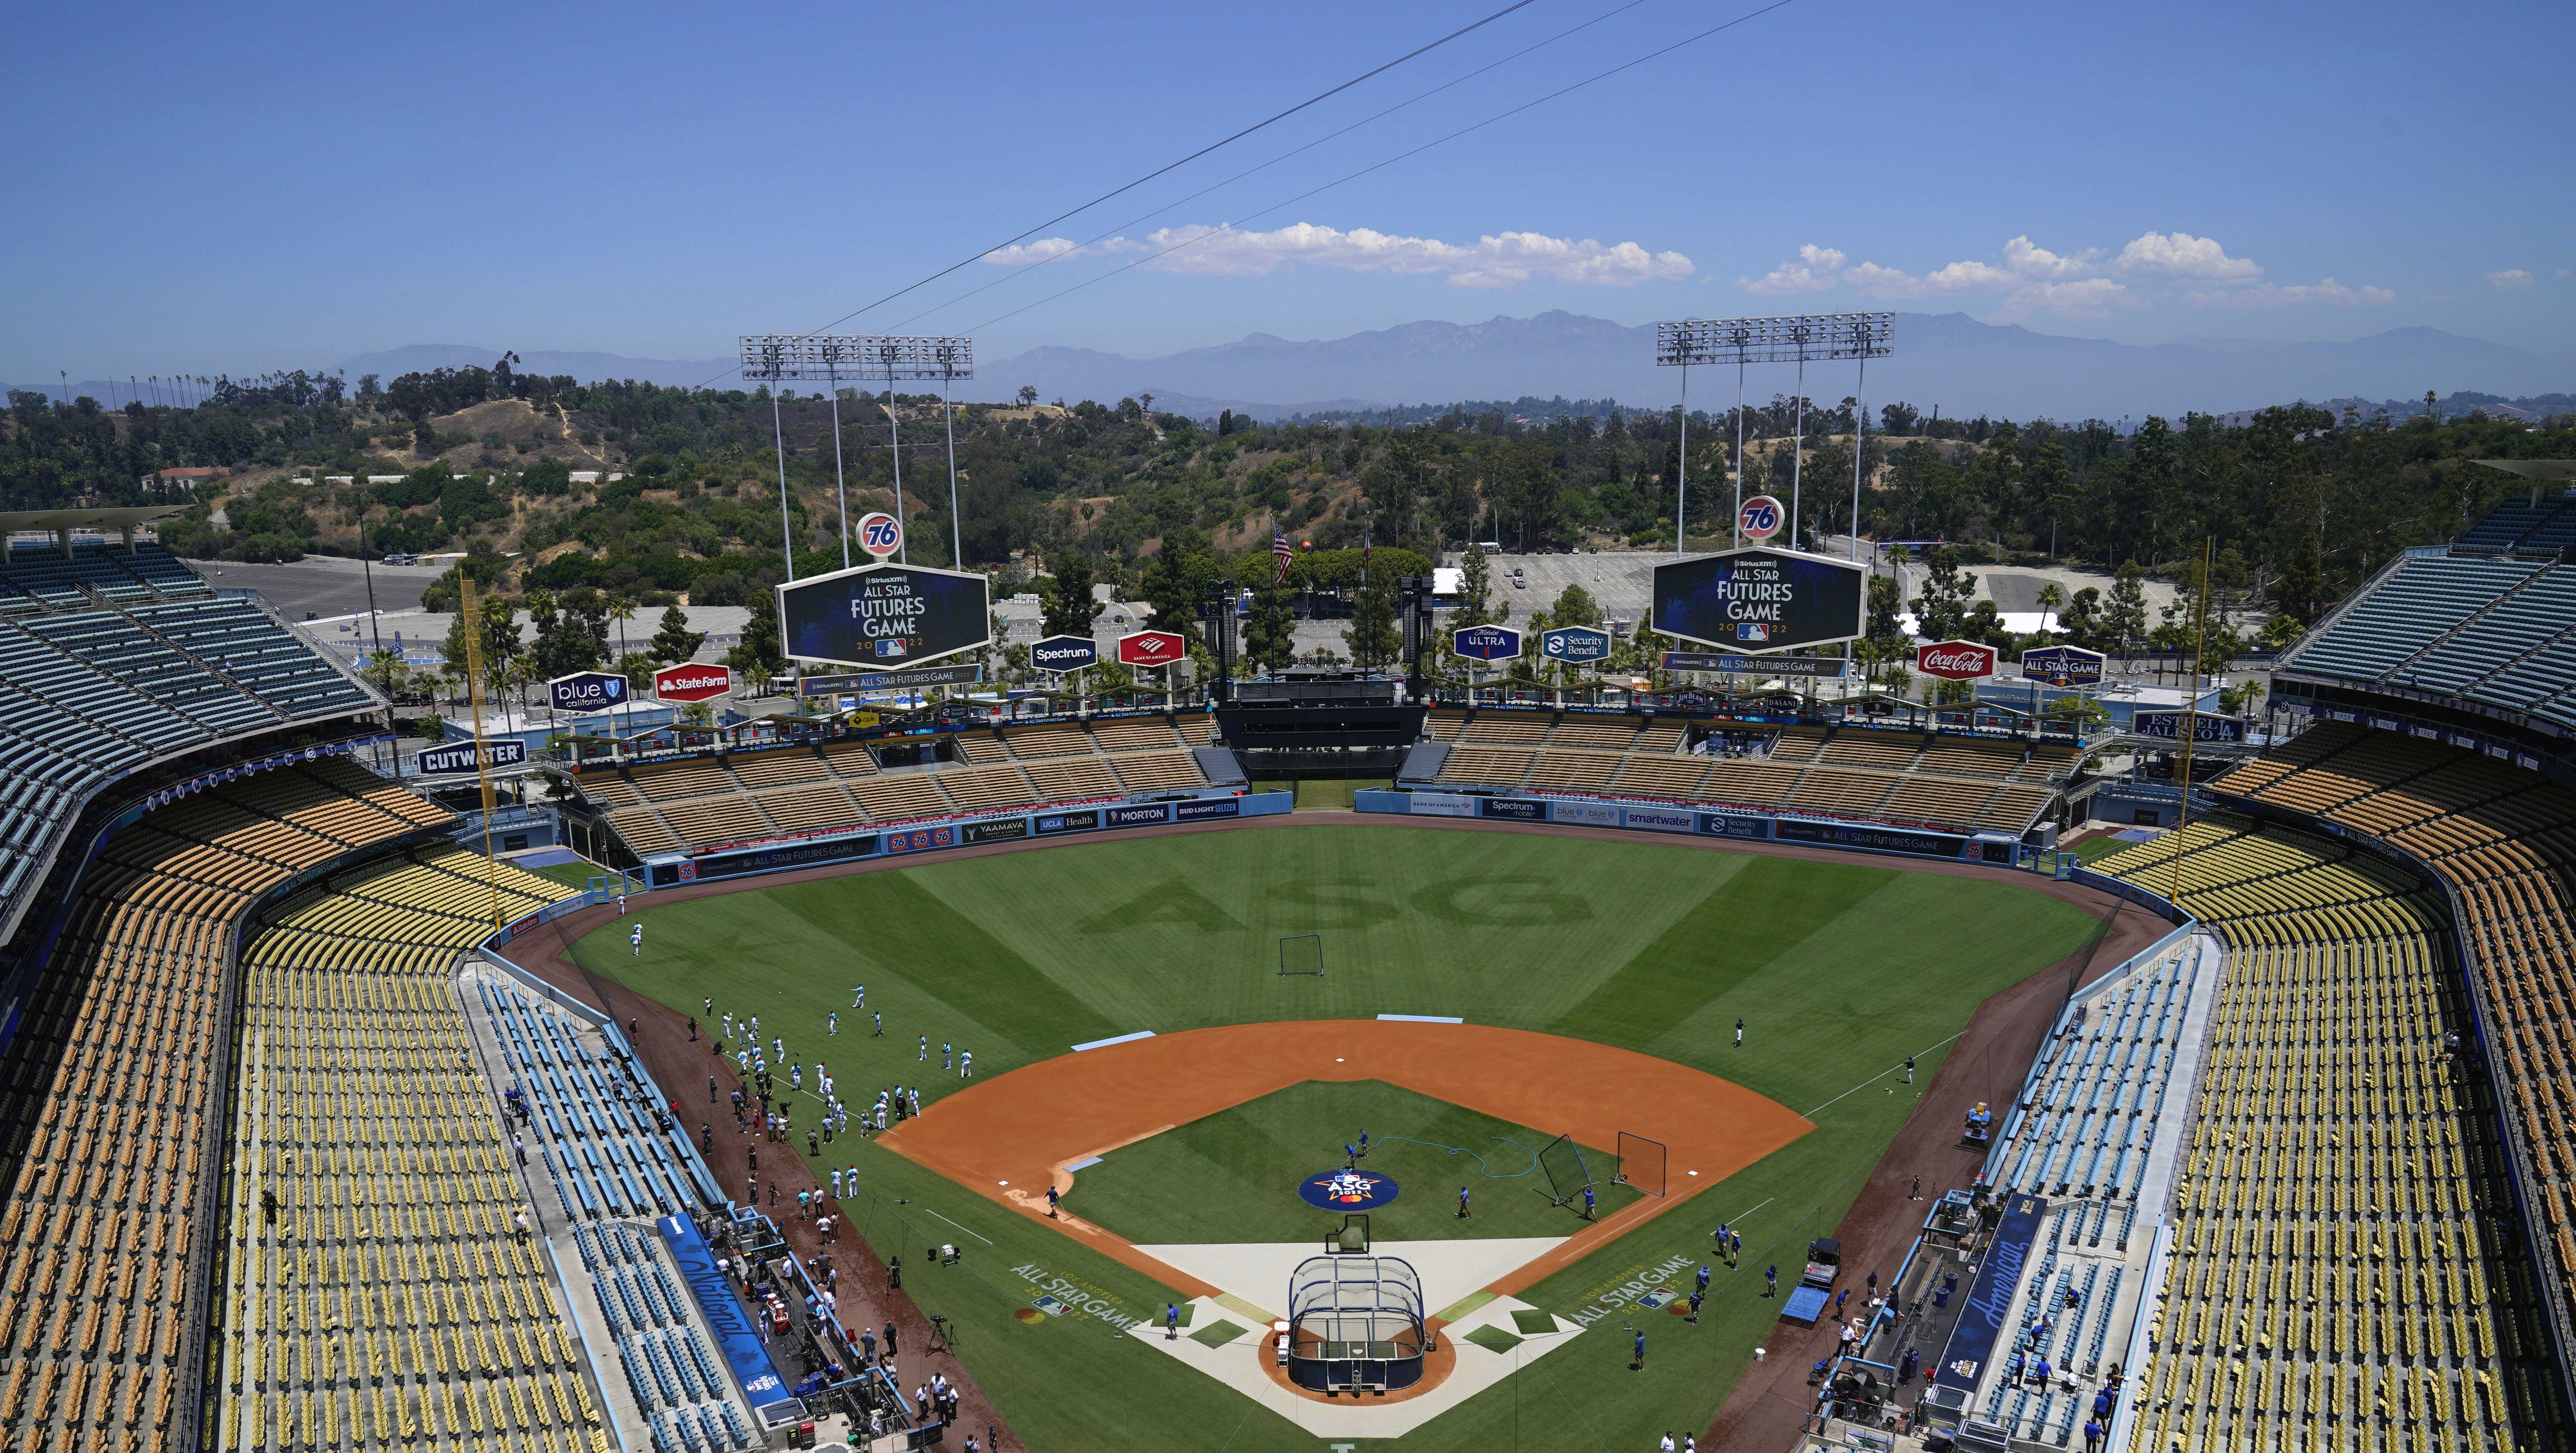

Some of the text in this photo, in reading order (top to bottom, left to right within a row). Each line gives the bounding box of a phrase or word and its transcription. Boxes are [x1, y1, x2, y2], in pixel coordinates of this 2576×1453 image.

[1743, 505, 1776, 530] 76
[866, 521, 897, 547] 76
[1732, 569, 1779, 581] ALL STAR
[864, 585, 910, 597] ALL STAR
[1717, 581, 1792, 602] FUTURES
[851, 597, 925, 618] FUTURES
[1727, 601, 1780, 620] GAME
[863, 617, 916, 637] GAME
[1469, 636, 1506, 645] ULTRA
[1568, 636, 1603, 647] Security
[1037, 648, 1088, 661] Spectrum
[1568, 646, 1598, 655] Benefit
[1735, 660, 1754, 669] STAR
[1756, 661, 1789, 670] FUTURES
[1791, 663, 1815, 671] GAME
[1924, 650, 1988, 672] Coca-Cola
[2026, 661, 2099, 674] ALL STAR GAME
[860, 678, 875, 687] ALL
[877, 676, 896, 686] STAR
[897, 674, 930, 684] FUTURES
[930, 672, 953, 681] GAME
[558, 682, 601, 700] blue
[567, 698, 606, 707] california
[1677, 693, 1703, 703] JIM BEAM
[2340, 680, 2406, 697] DODGER
[2418, 694, 2488, 715] STADIUM
[2142, 725, 2213, 739] JALISCO
[2460, 738, 2470, 746] 1981
[307, 751, 315, 759] 42
[425, 745, 518, 770] CUTWATER
[2494, 748, 2505, 757] 1988
[1215, 803, 1236, 813] SELTZER
[1493, 801, 1532, 813] Spectrum
[1557, 806, 1575, 815] blue
[1121, 809, 1163, 821] MORTON
[1589, 809, 1607, 818] blue
[1066, 816, 1093, 827] Health
[1629, 814, 1691, 827] smartwater
[1728, 818, 1756, 828] Security
[935, 831, 948, 842] 76
[1728, 826, 1753, 835] Benefit
[893, 837, 905, 848] 76
[914, 834, 927, 845] 76
[1833, 831, 1847, 840] ALL
[1851, 832, 1871, 843] STAR
[1873, 836, 1910, 847] FUTURES
[1911, 839, 1938, 850] GAME
[755, 857, 768, 866] ALL
[772, 854, 791, 863] STAR
[793, 848, 828, 860] FUTURES
[829, 845, 853, 857] GAME
[1968, 846, 1980, 855] 76
[681, 866, 693, 877] 76
[1073, 875, 1597, 933] ASG
[1328, 1180, 1371, 1191] ASG
[1060, 1271, 1124, 1304] LOS ANGELES
[1582, 1265, 1643, 1300] LOS ANGELES
[1970, 1240, 2031, 1329] American
[1570, 1255, 1695, 1326] ALL STAR GAME
[678, 1260, 758, 1343] National
[1010, 1264, 1143, 1331] ALL STAR GAME
